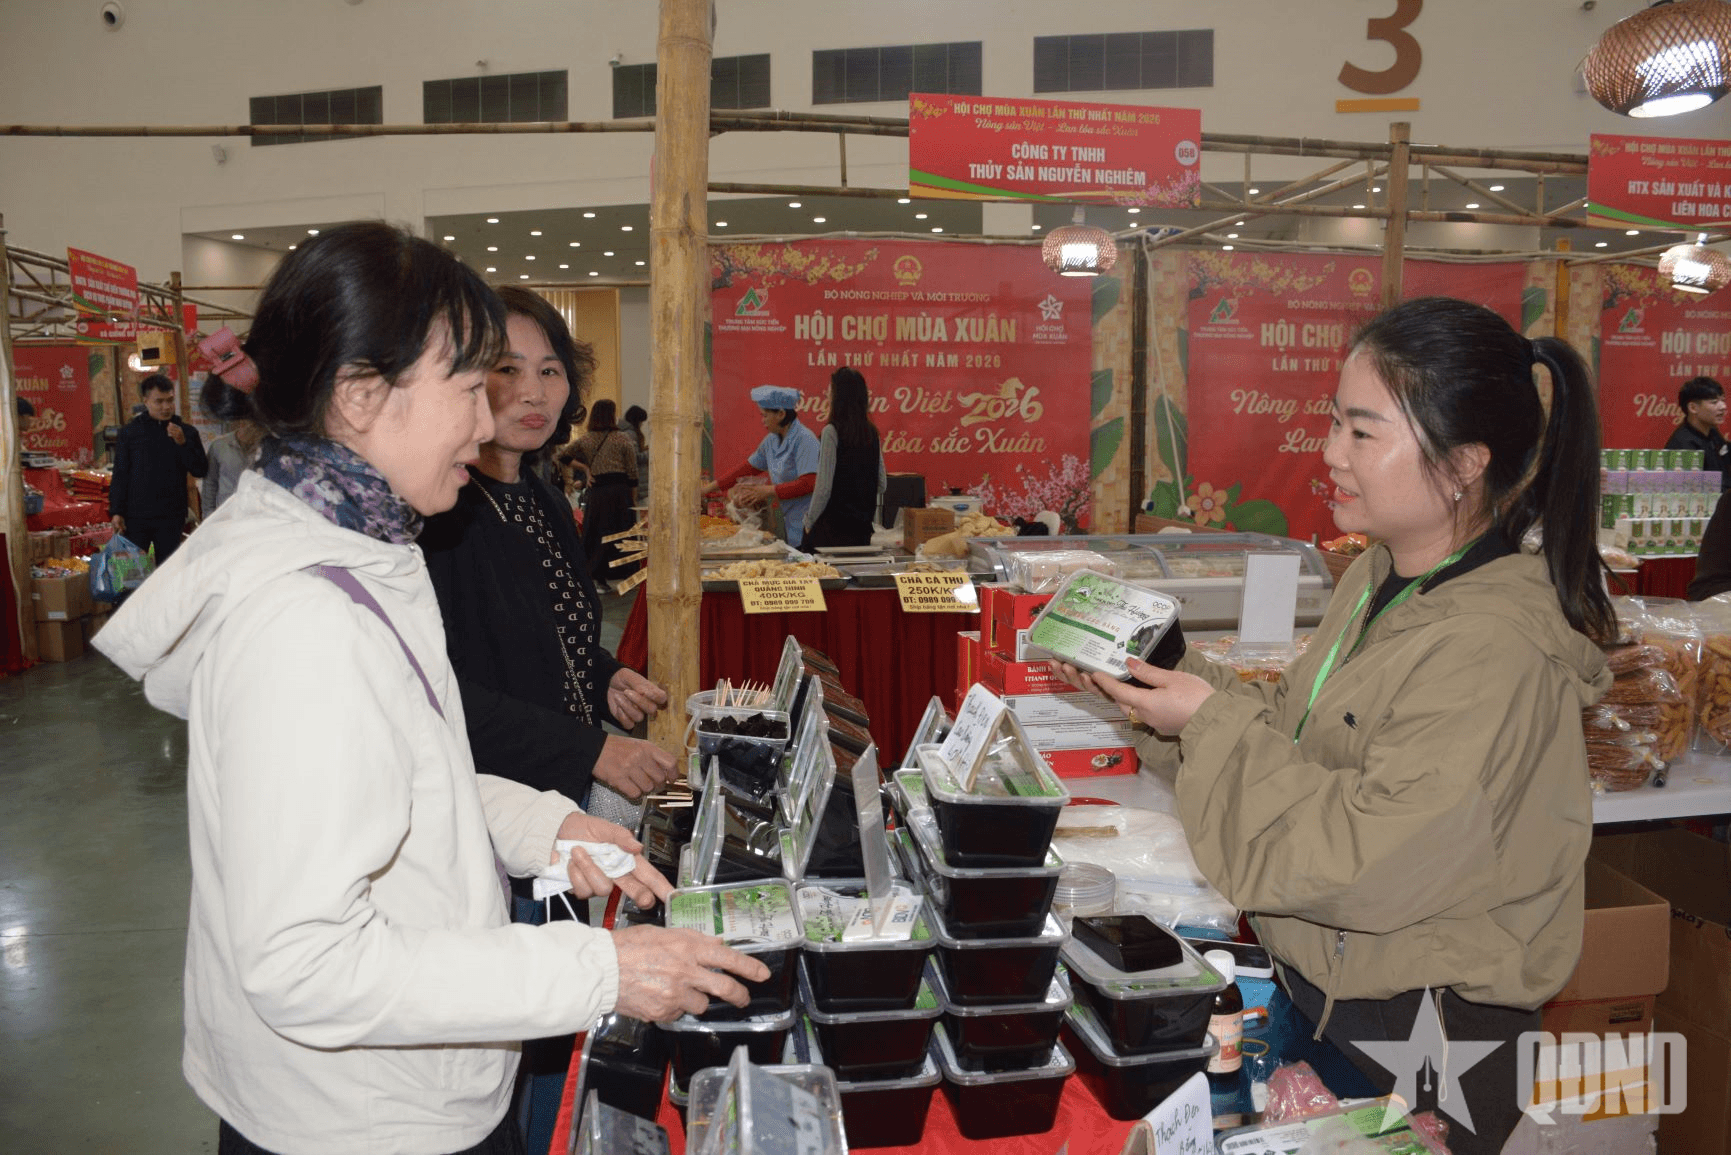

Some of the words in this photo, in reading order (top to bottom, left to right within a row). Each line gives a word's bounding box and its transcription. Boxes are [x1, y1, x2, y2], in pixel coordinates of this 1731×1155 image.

[1337, 0, 1422, 94] 3
[953, 101, 970, 117] HỘI
[973, 104, 993, 117] CHỢ
[995, 103, 1016, 117] MÙA
[1019, 104, 1045, 118] XUÂN
[1047, 105, 1066, 119] LẦN
[1068, 106, 1087, 120] THỨ
[1088, 107, 1113, 122] NHẤT
[1114, 109, 1137, 123] NĂM
[1011, 141, 1049, 160] CÔNG
[1052, 146, 1068, 161] TY
[1071, 146, 1106, 163] TNHH
[969, 159, 1003, 179] THỦY
[1006, 160, 1034, 181] SẢN
[1038, 162, 1091, 184] NGUYỄN
[1095, 167, 1146, 186] NGHIÊM
[1628, 180, 1649, 195] HTX
[1652, 177, 1675, 196] SẢN
[1677, 178, 1705, 197] XUẤT
[1707, 181, 1721, 198] VÀ
[1698, 203, 1720, 217] HOA
[824, 290, 839, 300] BỘ
[840, 290, 871, 300] NÔNG
[871, 291, 909, 302] NGHIỆP
[911, 291, 924, 301] VÀ
[926, 292, 946, 302] MÔI
[794, 309, 834, 346] HỘI
[841, 313, 888, 346] CHỢ
[895, 311, 948, 342] MÙA
[954, 312, 1016, 343] XUÂN
[1260, 318, 1296, 352] HỘI
[1302, 323, 1344, 352] CHỢ
[1661, 327, 1690, 359] HỘI
[808, 349, 838, 367] LẦN
[844, 350, 874, 367] THỨ
[880, 349, 919, 367] NHẤT
[925, 352, 959, 368] NĂM
[965, 354, 1001, 368] 2026
[1272, 353, 1298, 372] LẦN
[1304, 357, 1330, 372] THỨ
[1670, 361, 1692, 377] LẦN
[894, 387, 954, 418] Việt
[957, 377, 1044, 427] 2026
[1230, 388, 1298, 424] Nông
[1634, 393, 1686, 425] Nông
[882, 430, 925, 453] tỏa
[929, 426, 971, 453] sắc
[975, 427, 1047, 453] Xuân
[899, 574, 923, 584] CHẢ
[924, 575, 941, 584] CÁ
[942, 576, 964, 585] THU
[918, 596, 939, 604] 0989
